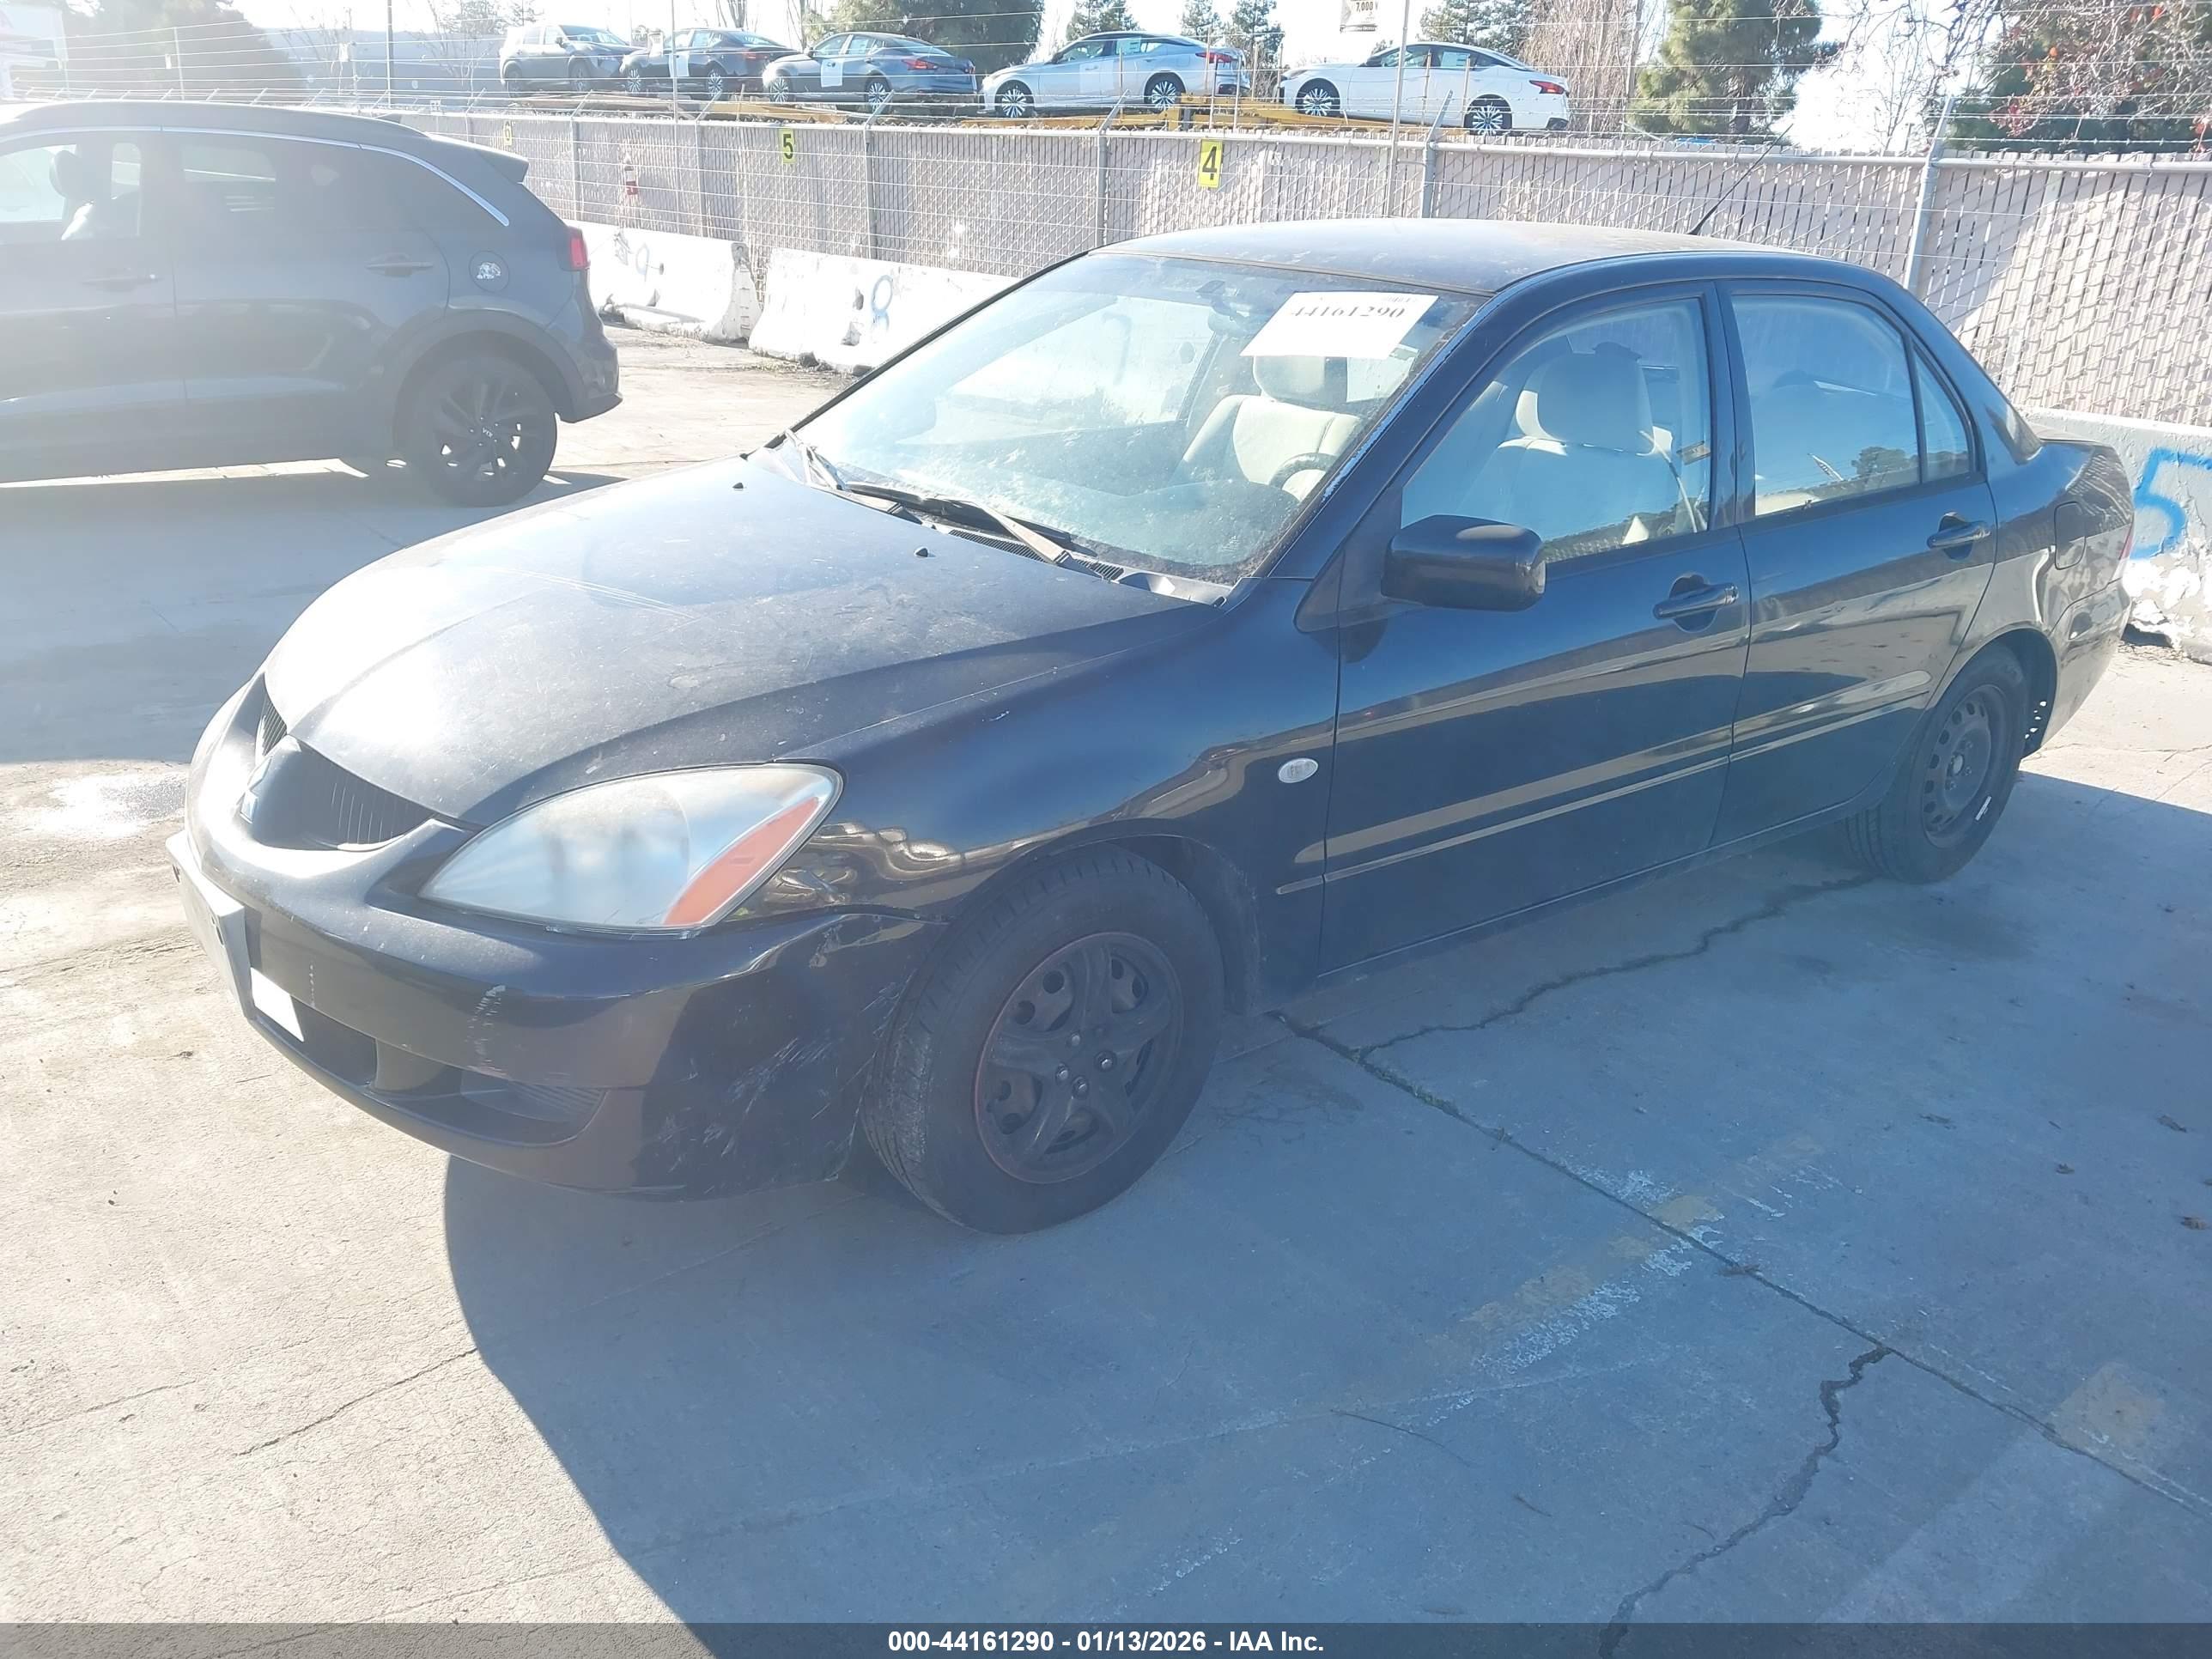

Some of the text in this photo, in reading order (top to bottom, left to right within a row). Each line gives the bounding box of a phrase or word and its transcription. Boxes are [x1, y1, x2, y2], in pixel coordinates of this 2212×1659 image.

[782, 133, 794, 160] 5
[1201, 146, 1218, 180] 4
[2130, 447, 2212, 559] 5
